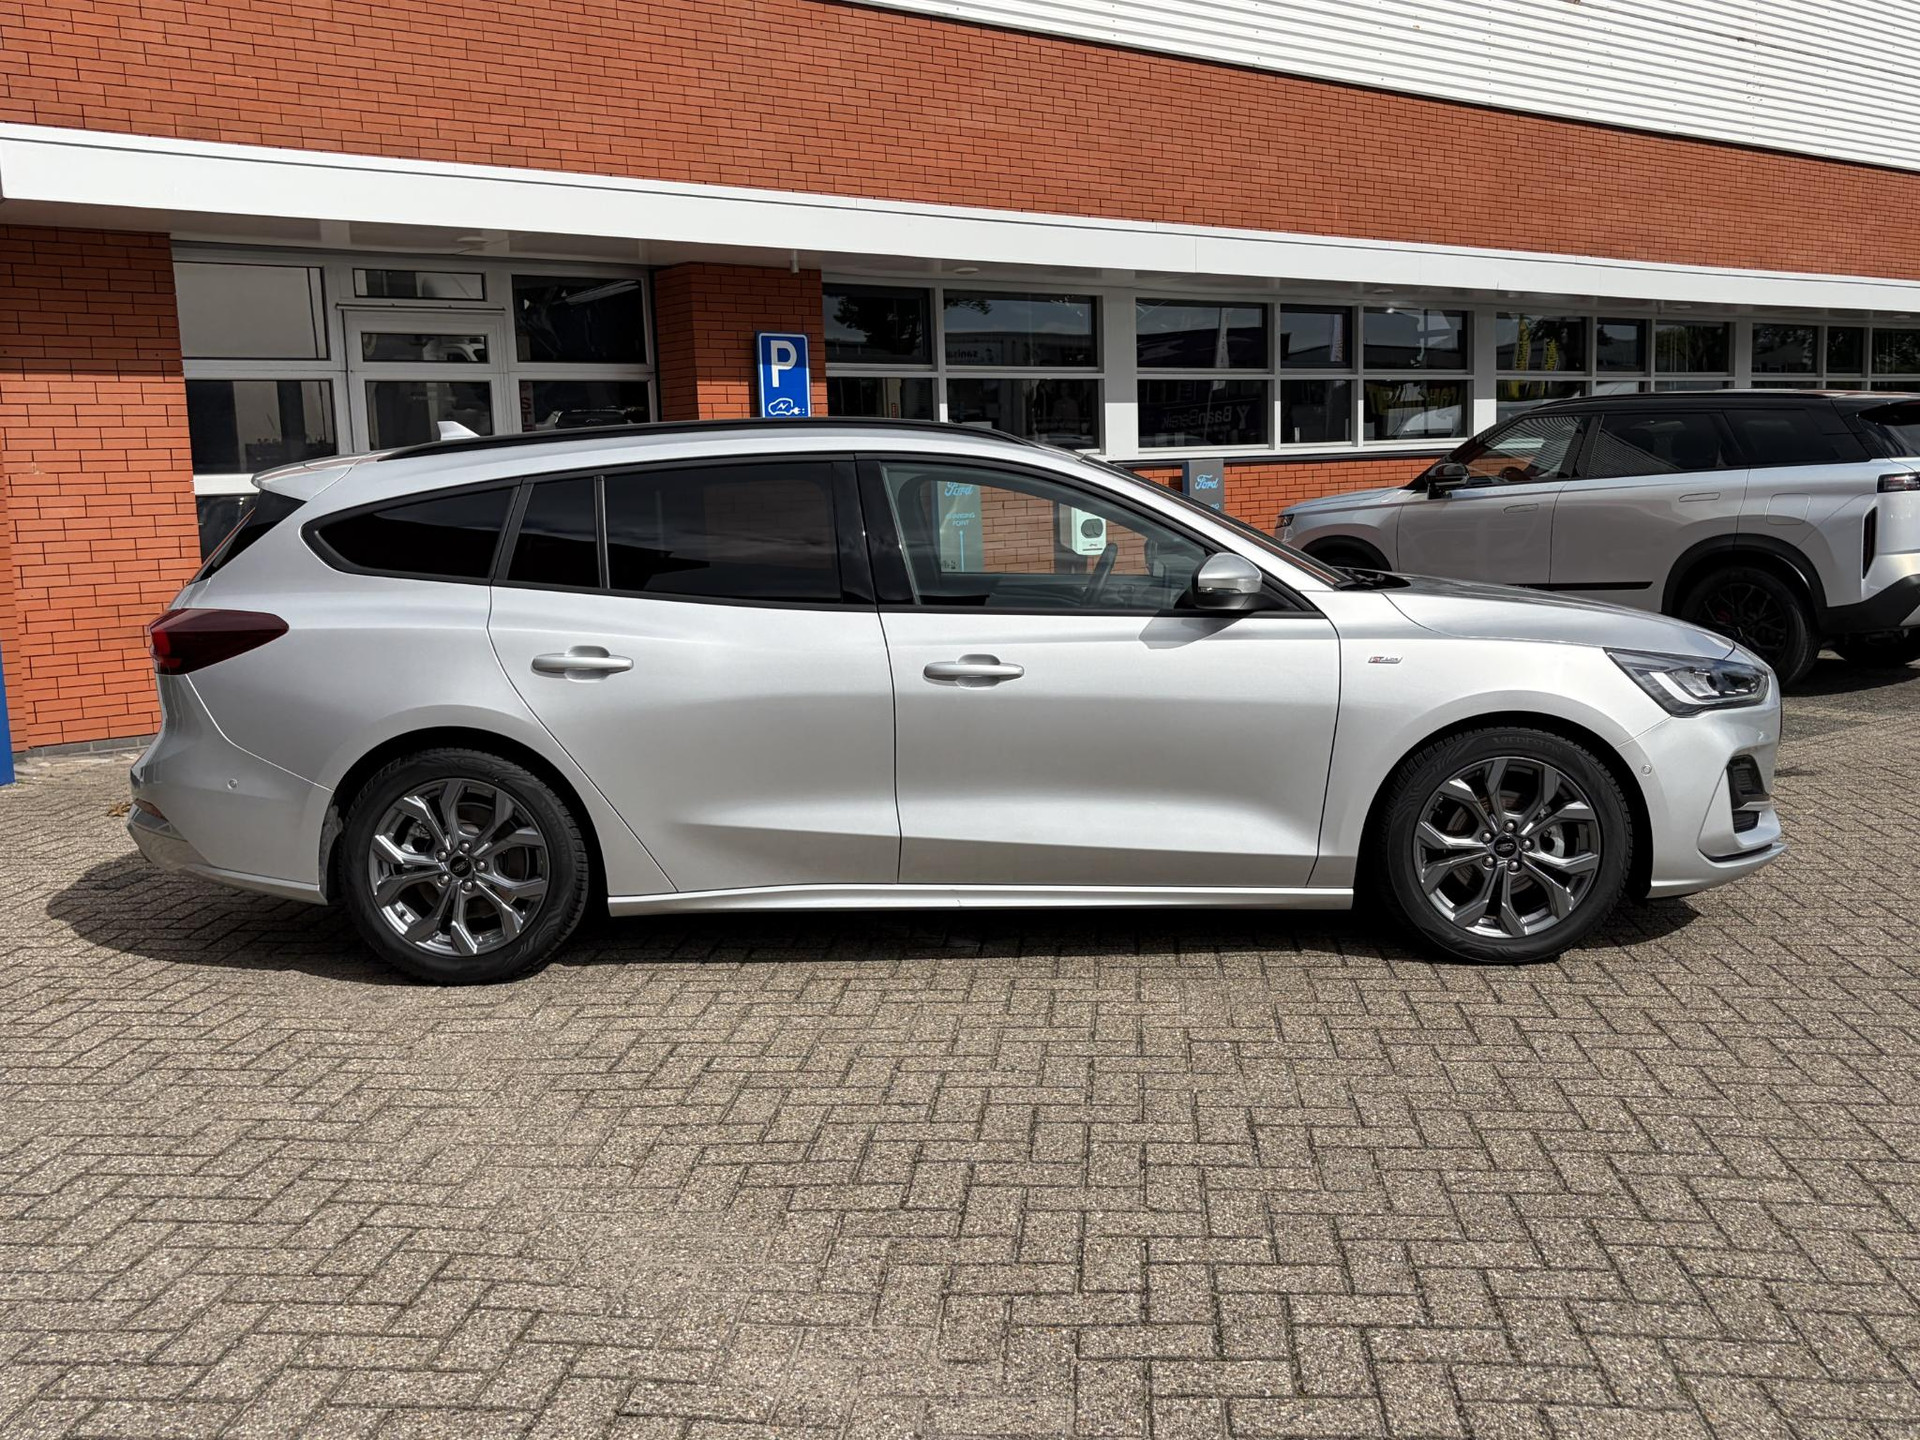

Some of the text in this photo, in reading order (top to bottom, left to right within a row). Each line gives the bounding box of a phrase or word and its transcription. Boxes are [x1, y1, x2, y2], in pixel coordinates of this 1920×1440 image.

[770, 340, 798, 388] P
[944, 481, 974, 497] Ford
[1194, 474, 1219, 490] Ford
